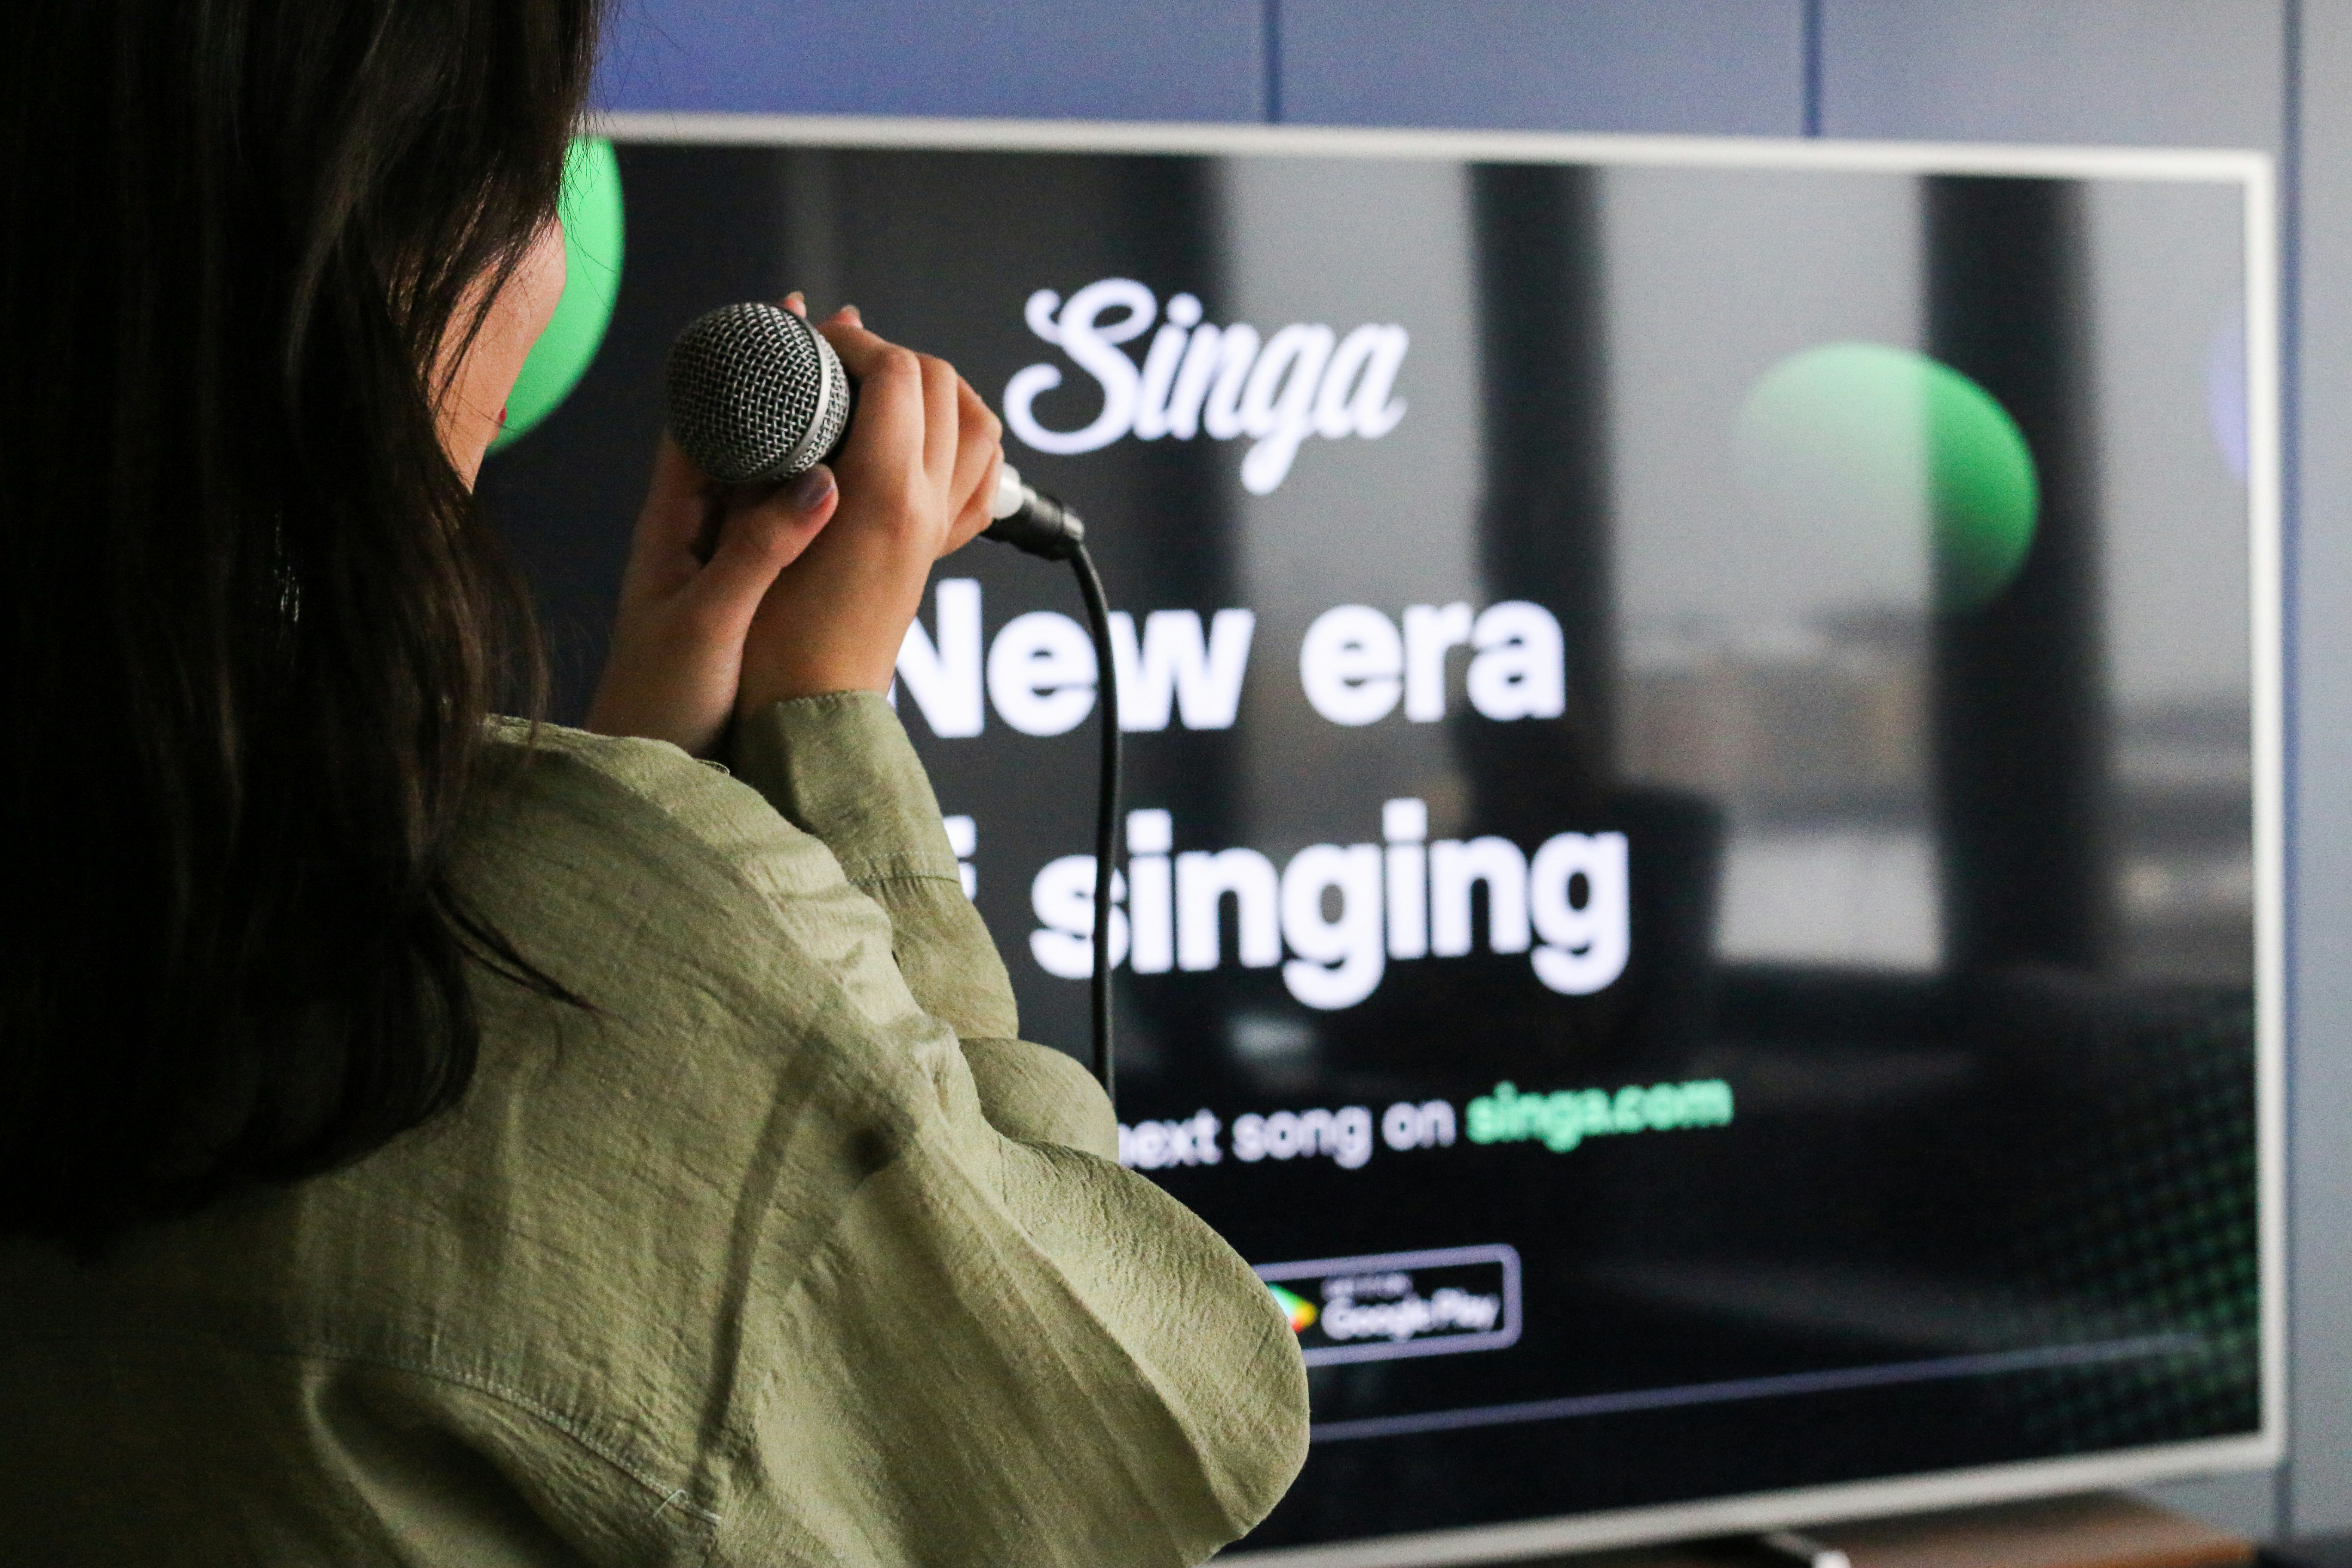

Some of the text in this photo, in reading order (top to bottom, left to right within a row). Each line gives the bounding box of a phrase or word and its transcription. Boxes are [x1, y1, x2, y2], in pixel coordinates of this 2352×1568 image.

[1003, 279, 1409, 494] Singa
[888, 577, 1565, 738] New era
[1030, 798, 1630, 1010] singing
[1232, 1106, 1373, 1169] song
[1381, 1099, 1457, 1151] on
[1466, 1079, 1734, 1153] singa.com
